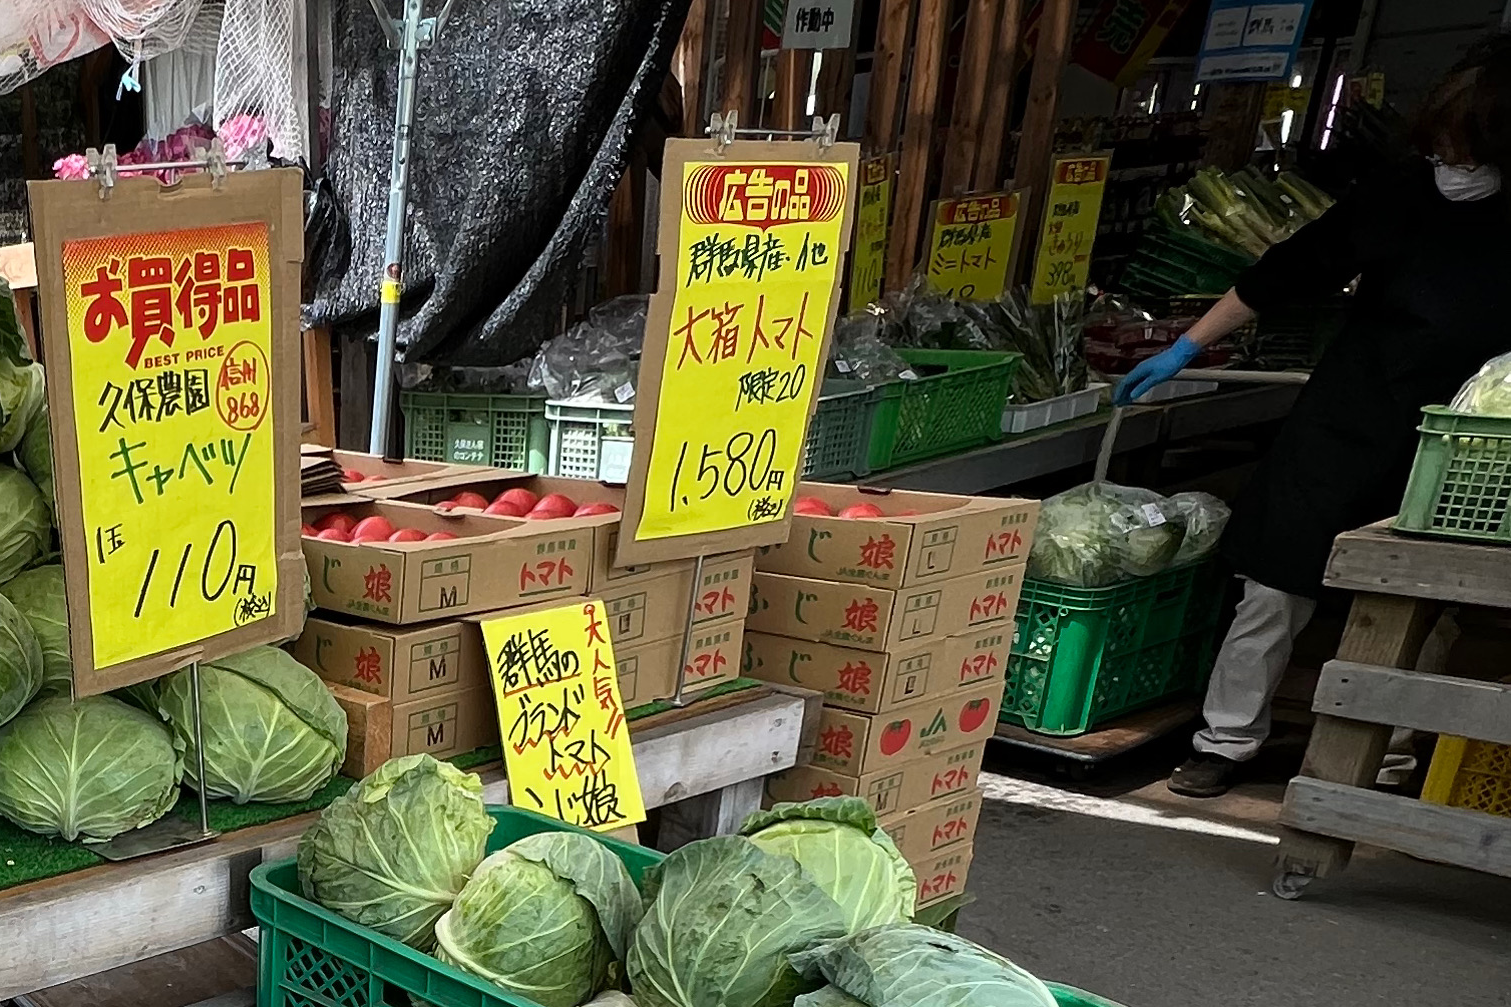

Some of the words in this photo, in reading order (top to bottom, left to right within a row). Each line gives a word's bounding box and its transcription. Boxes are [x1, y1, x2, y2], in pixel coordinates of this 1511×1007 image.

[795, 5, 835, 33] 作動中
[718, 168, 811, 221] 広告の品
[931, 246, 997, 275] ミニトマト
[80, 248, 261, 370] お買得品
[673, 291, 814, 371] 大箱トマト
[144, 353, 180, 369] BEST
[185, 345, 225, 362] PRICE
[220, 356, 257, 391] 信州
[98, 368, 210, 433] 久保農園
[734, 363, 806, 412] 限定20
[226, 391, 261, 425] 868
[109, 432, 252, 505] キャベツ
[985, 528, 1022, 559] トマト
[519, 556, 573, 592] トマト
[440, 585, 457, 608] M
[969, 591, 1007, 621] トマト
[429, 655, 447, 680] M
[496, 628, 580, 694] 群馬の
[960, 650, 998, 682] トマト
[508, 683, 585, 747] ブランド
[426, 723, 444, 746] M
[550, 729, 611, 772] トマト
[820, 724, 854, 758] 娘
[931, 764, 968, 795] トマト
[932, 816, 967, 847] トマト
[920, 870, 957, 900] トマト
